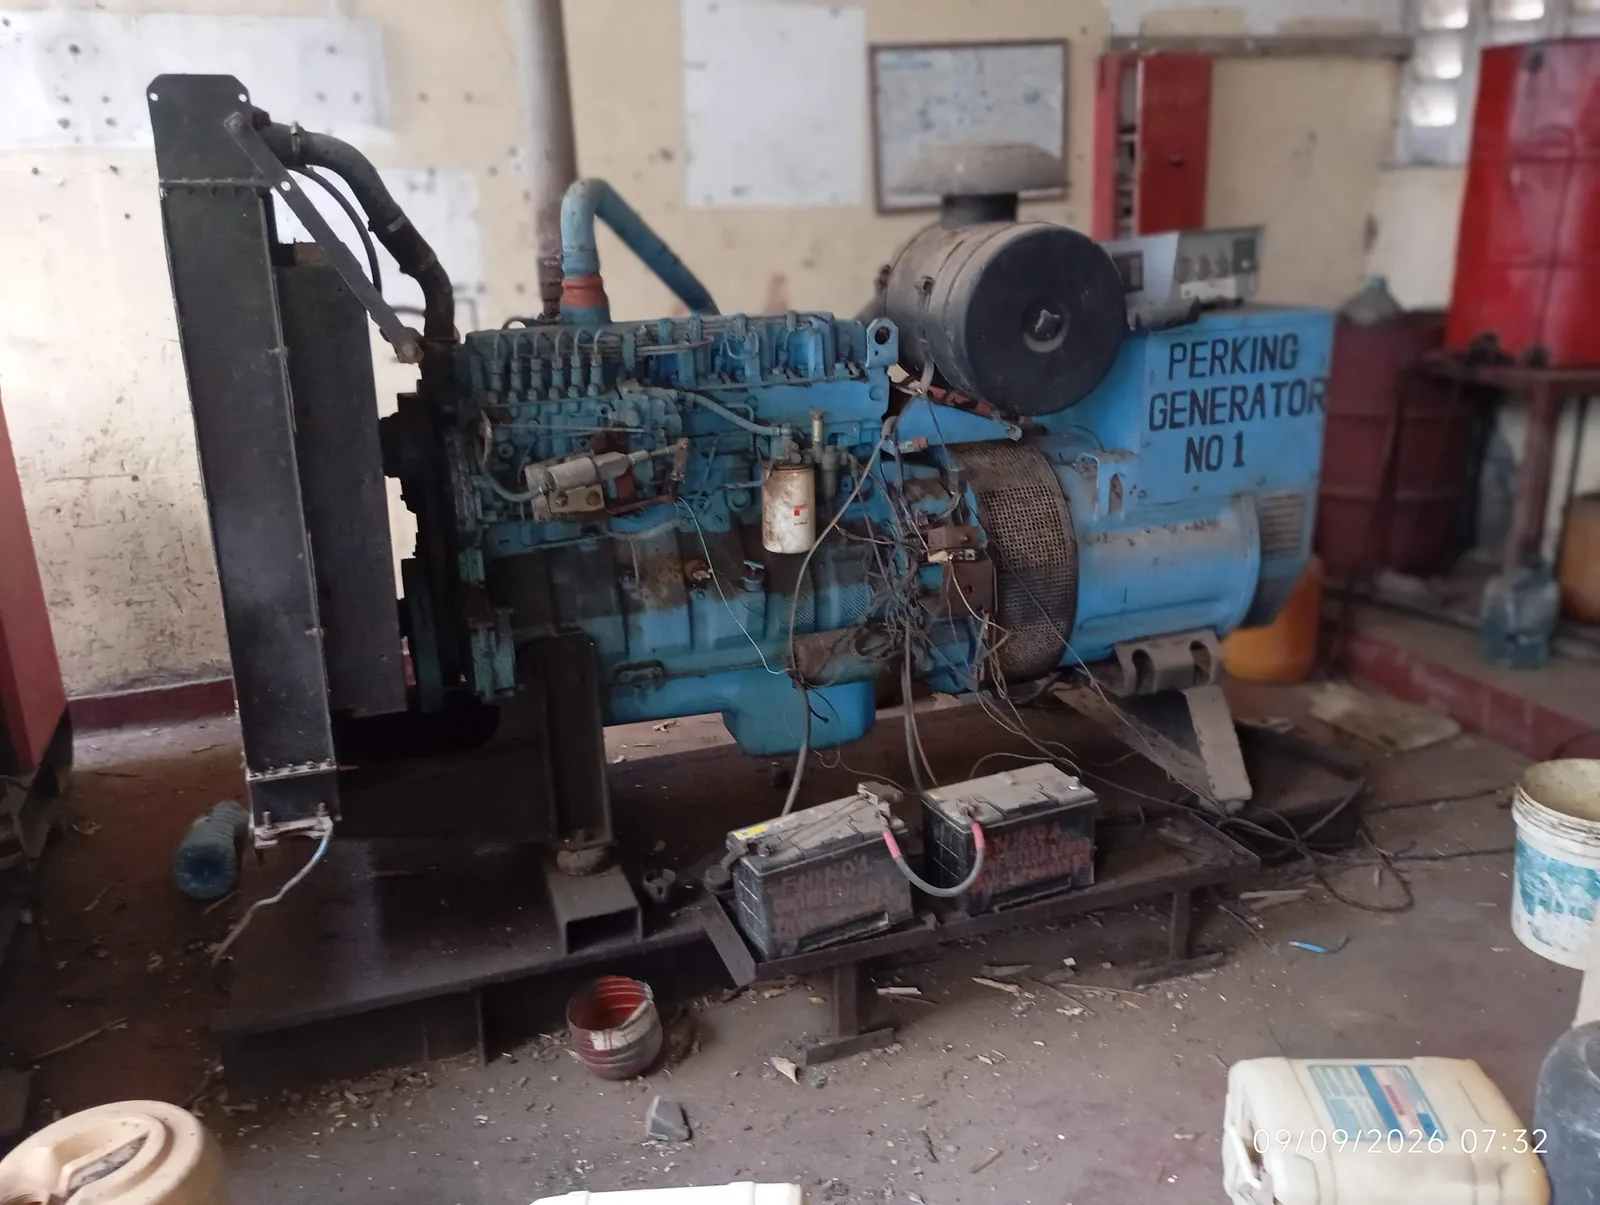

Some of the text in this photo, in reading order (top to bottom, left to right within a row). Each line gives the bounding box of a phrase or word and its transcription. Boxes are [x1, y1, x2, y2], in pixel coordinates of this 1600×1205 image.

[1168, 333, 1299, 380] PERKING
[1150, 377, 1327, 431] GENERATOR
[1184, 430, 1245, 474] NO 1
